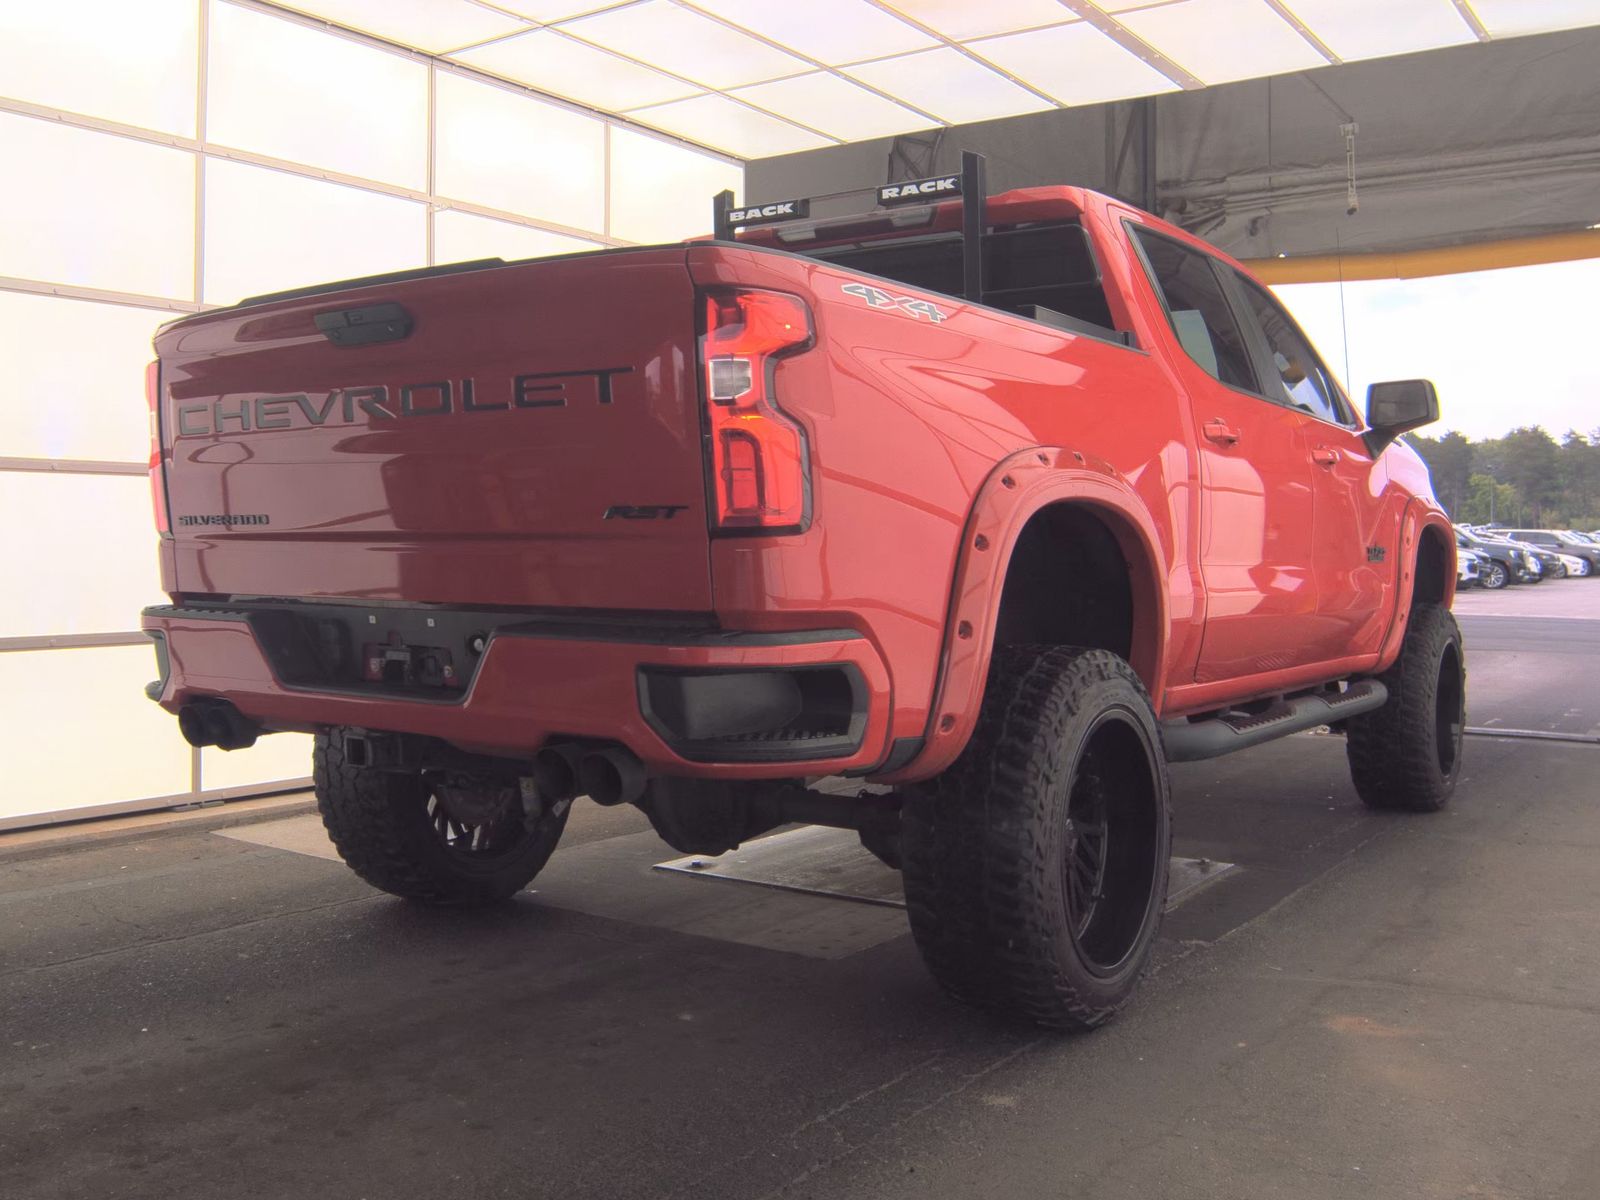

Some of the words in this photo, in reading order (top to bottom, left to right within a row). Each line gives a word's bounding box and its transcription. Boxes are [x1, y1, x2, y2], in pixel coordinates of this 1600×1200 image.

[729, 203, 794, 222] BACK
[881, 178, 956, 200] RACK
[178, 366, 636, 436] CHEVROLET
[178, 513, 271, 527] SILVERADO
[602, 505, 690, 520] RST
